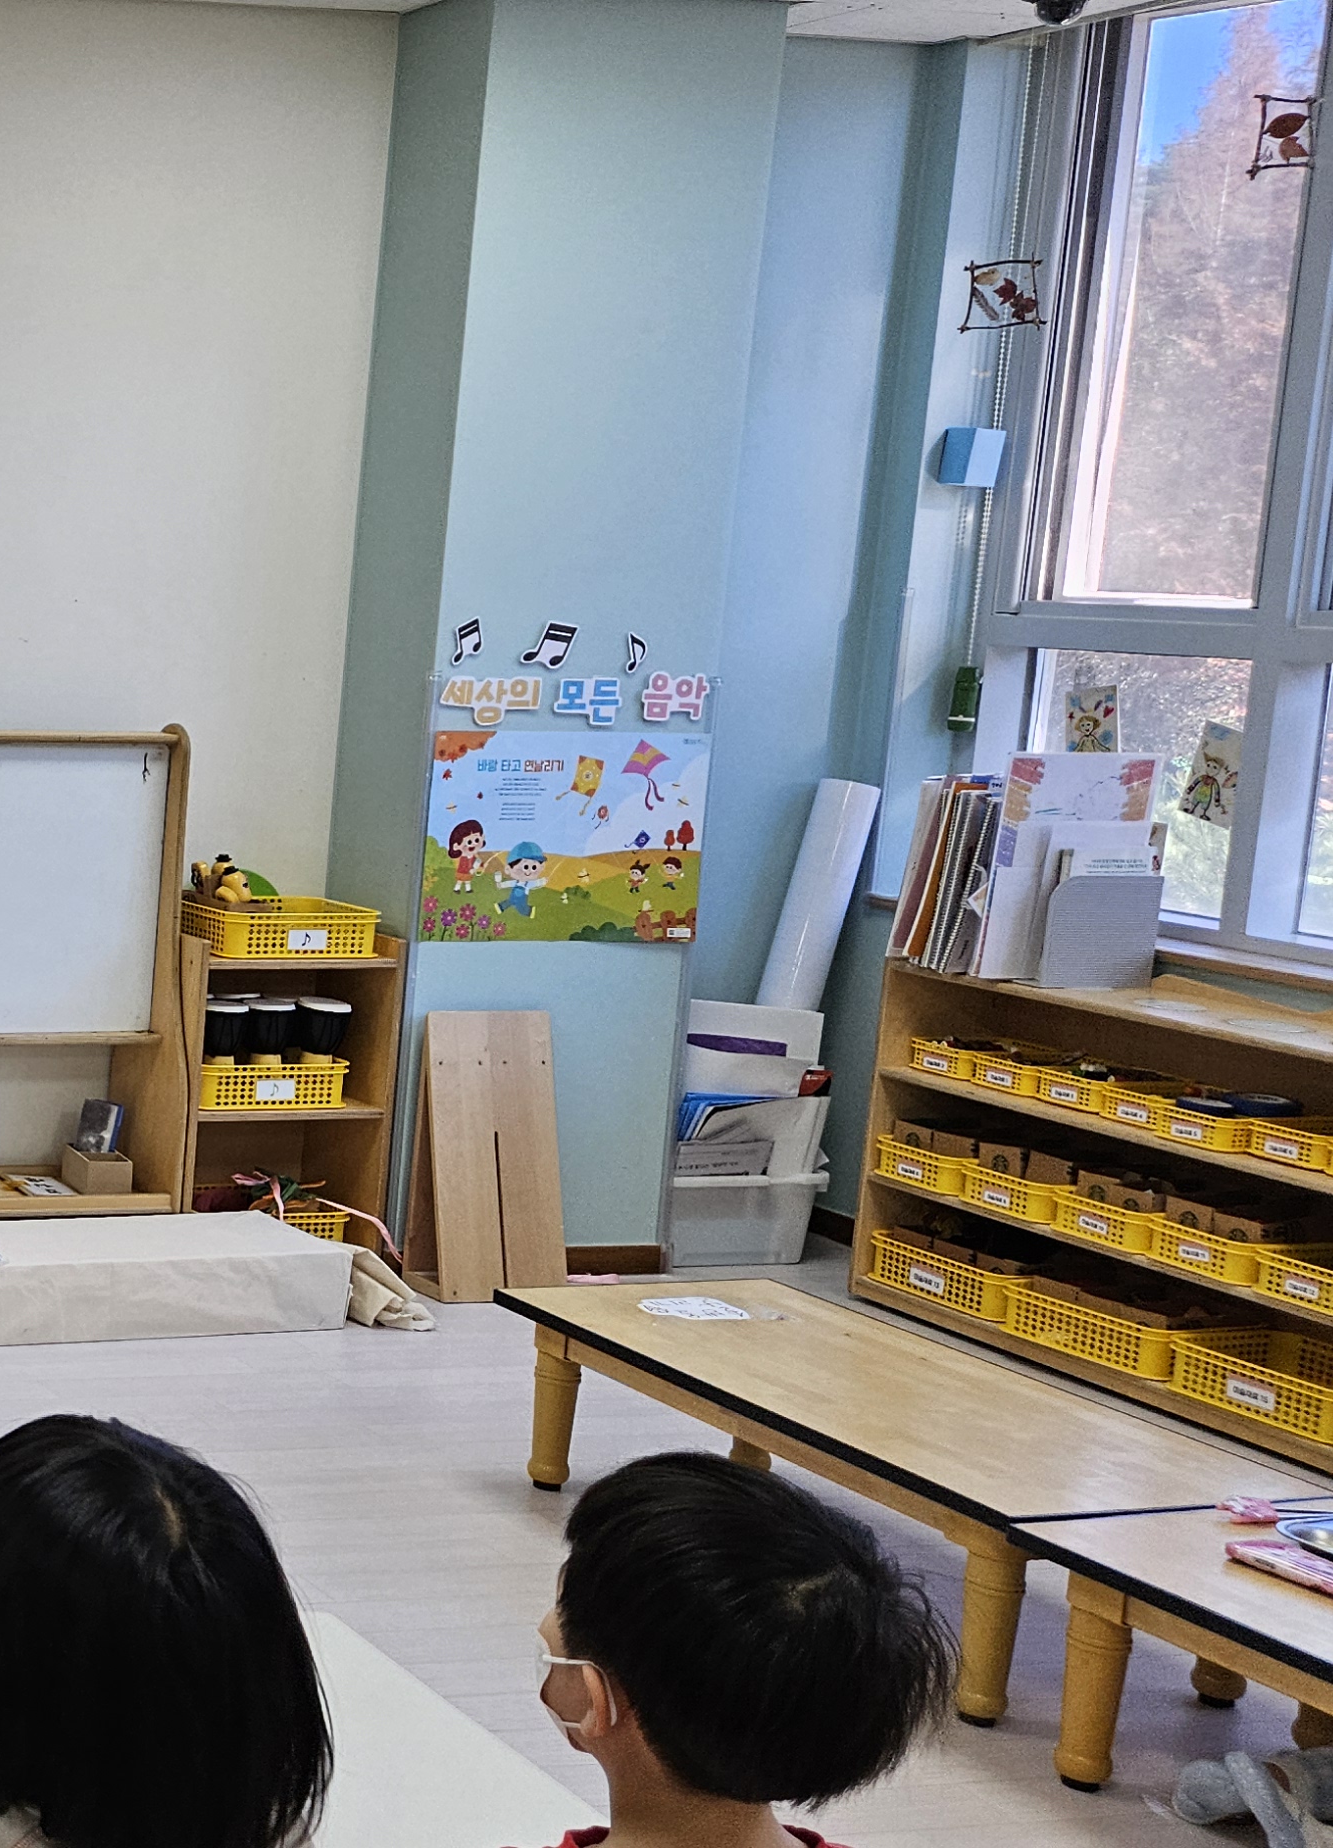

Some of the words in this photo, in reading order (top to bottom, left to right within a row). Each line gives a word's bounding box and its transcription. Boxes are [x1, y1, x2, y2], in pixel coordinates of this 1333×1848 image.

[442, 678, 541, 724] 세상의
[556, 679, 622, 724] 모든
[642, 673, 708, 720] 음악
[477, 759, 498, 772] 바람
[501, 759, 521, 772] 타고
[524, 759, 565, 772] 연날리기
